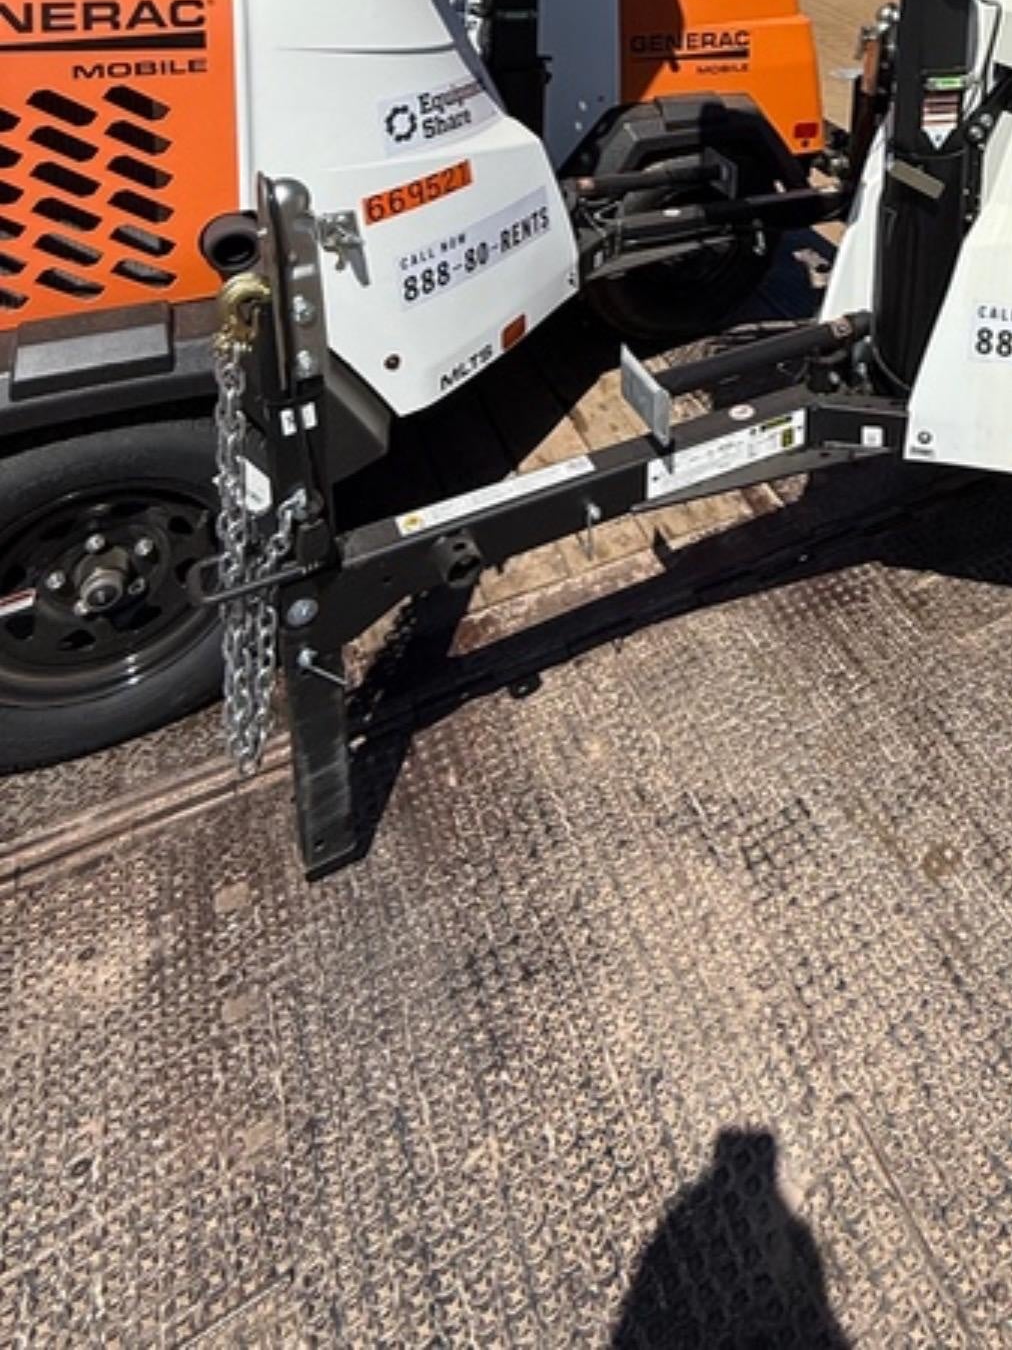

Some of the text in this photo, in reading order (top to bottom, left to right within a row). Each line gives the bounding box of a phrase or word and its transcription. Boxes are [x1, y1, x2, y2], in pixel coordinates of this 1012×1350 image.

[630, 30, 750, 54] GENERAC
[73, 59, 207, 80] MOBILE
[423, 109, 472, 139] Share
[368, 159, 472, 223] 669521
[400, 248, 435, 271] CALL
[403, 205, 550, 301] 888-80-RENTS
